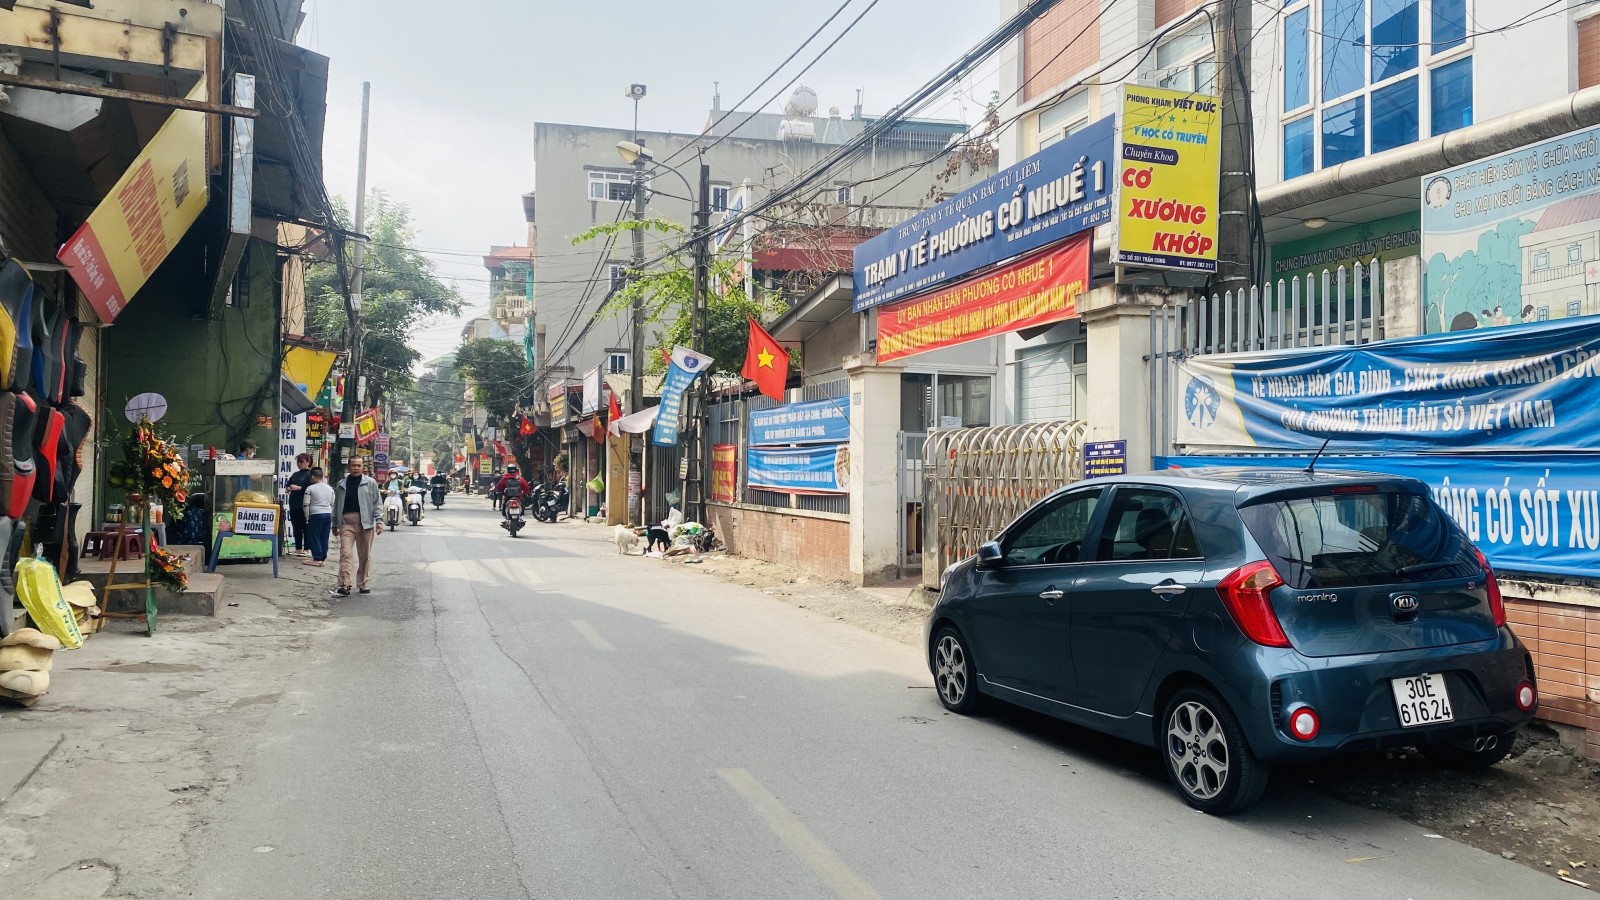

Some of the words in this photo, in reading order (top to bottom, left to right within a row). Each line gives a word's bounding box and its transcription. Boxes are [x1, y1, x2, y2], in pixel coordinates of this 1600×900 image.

[1126, 93, 1150, 104] PHÒNG
[1152, 96, 1172, 108] KHÁM
[1174, 98, 1194, 112] VIỆT
[1196, 100, 1216, 113] ĐỨC
[1141, 128, 1160, 140] HỌC
[1162, 126, 1174, 140] CỔ
[1176, 130, 1208, 144] TRUYỀN
[1124, 146, 1152, 160] Chuyên
[1154, 150, 1174, 162] Khoa
[1454, 170, 1477, 192] PHÁT
[1478, 164, 1500, 187] HIỆN
[1502, 158, 1524, 179] SỚM
[1526, 152, 1539, 174] VÀ
[1542, 144, 1570, 169] CHỮA
[1573, 134, 1599, 162] KHỎI
[1122, 166, 1154, 188] CƠ
[898, 220, 920, 240] TRUNG
[922, 214, 937, 228] TÂM
[938, 210, 944, 220] Y
[944, 204, 955, 218] TẾ
[956, 190, 979, 212] QUẬN
[981, 179, 996, 200] BẮC
[1000, 170, 1013, 190] TỪ
[1015, 160, 1042, 182] LIÊM
[1454, 199, 1473, 219] CHO
[1474, 194, 1492, 216] MỌI
[1494, 183, 1524, 209] NGƯỜI
[1526, 174, 1552, 200] BẰNG
[1556, 170, 1584, 193] CÁCH
[864, 254, 898, 286] TRẠM
[900, 248, 909, 272] Y
[910, 230, 930, 267] TẾ
[930, 210, 994, 260] PHƯỜNG
[998, 184, 1025, 231] CỔ
[1028, 154, 1088, 220] NHUẾ
[1091, 160, 1104, 192] 1
[1128, 198, 1206, 224] XƯƠNG
[1152, 230, 1212, 255] KHỚP
[1276, 256, 1298, 273] CHUNG
[1300, 252, 1313, 268] TAY
[1313, 248, 1328, 264] XÂY
[1328, 245, 1350, 264] DỰNG
[1380, 234, 1391, 251] TẾ
[1392, 226, 1421, 248] PHƯỜN
[908, 307, 921, 320] BAN
[922, 295, 942, 315] NHÂN
[944, 289, 960, 310] DÂN
[962, 276, 1000, 304] PHƯỜNG
[1048, 258, 1053, 276] 1
[1252, 372, 1266, 398] KẾ
[1268, 372, 1304, 402] HOẠCH
[1307, 368, 1332, 396] HÓA
[1334, 371, 1356, 396] GIA
[1359, 364, 1391, 394] ĐÌNH
[1403, 362, 1438, 393] CHÌA
[1441, 360, 1492, 391] KHÓA
[1492, 354, 1557, 386] THÀNH
[1561, 345, 1600, 380] CÔN
[1280, 404, 1304, 431] CỦA
[1306, 409, 1359, 432] CHƯƠNG
[1362, 403, 1402, 432] TRÌNH
[1406, 402, 1439, 432] DÂN
[1442, 396, 1466, 432] SỐ
[1469, 397, 1504, 436] VIỆT
[1508, 399, 1556, 429] NAM
[281, 424, 296, 440] YỂN
[238, 512, 259, 521] BÁNH
[262, 512, 274, 522] GIÒ
[1433, 476, 1480, 542] ÔNG
[1484, 477, 1514, 544] CÓ
[1519, 468, 1560, 548] SỐT
[1566, 489, 1600, 550] XU
[244, 522, 266, 532] NÓNG
[1297, 592, 1338, 602] morning
[1398, 597, 1416, 608] KIA
[1405, 676, 1436, 700] 30E
[1400, 698, 1451, 724] 616.24
